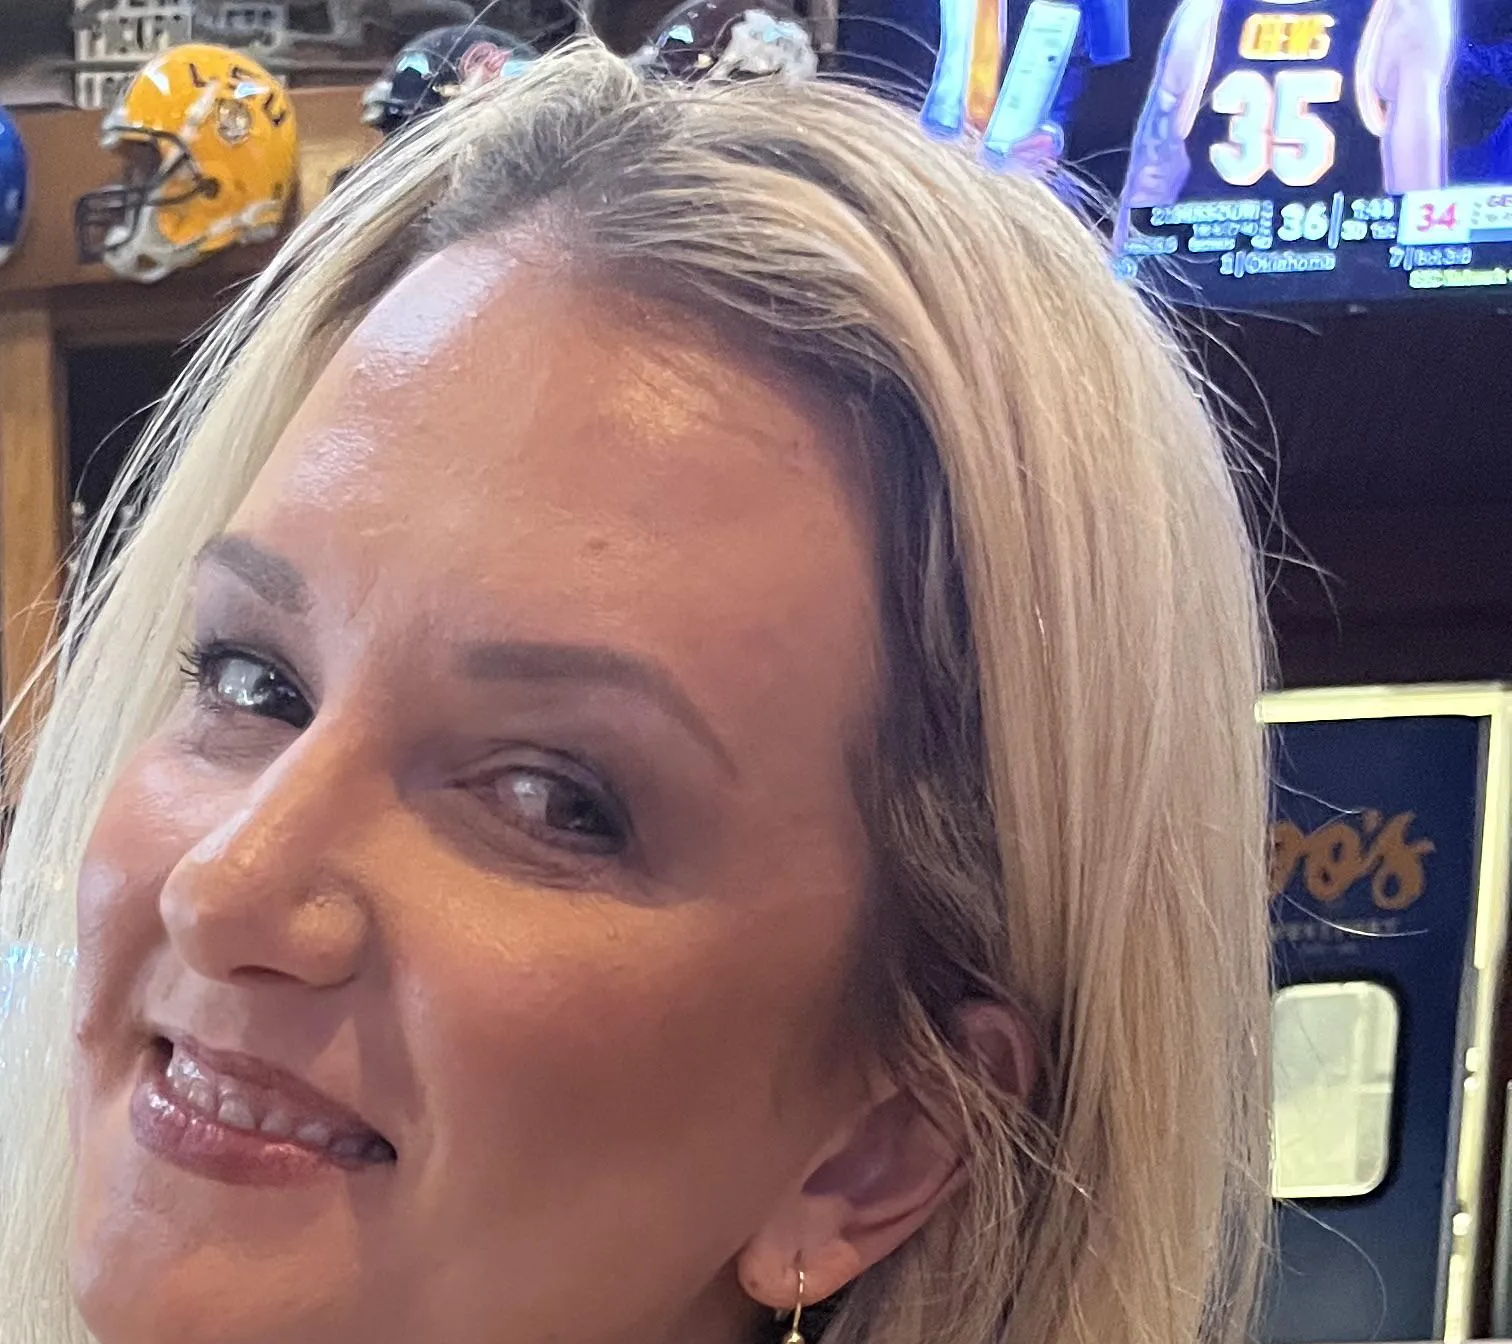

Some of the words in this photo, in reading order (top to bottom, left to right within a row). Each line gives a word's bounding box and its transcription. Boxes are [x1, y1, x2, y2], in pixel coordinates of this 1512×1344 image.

[1209, 70, 1343, 186] 35
[1277, 202, 1329, 241] 36
[1416, 203, 1457, 232] 34
